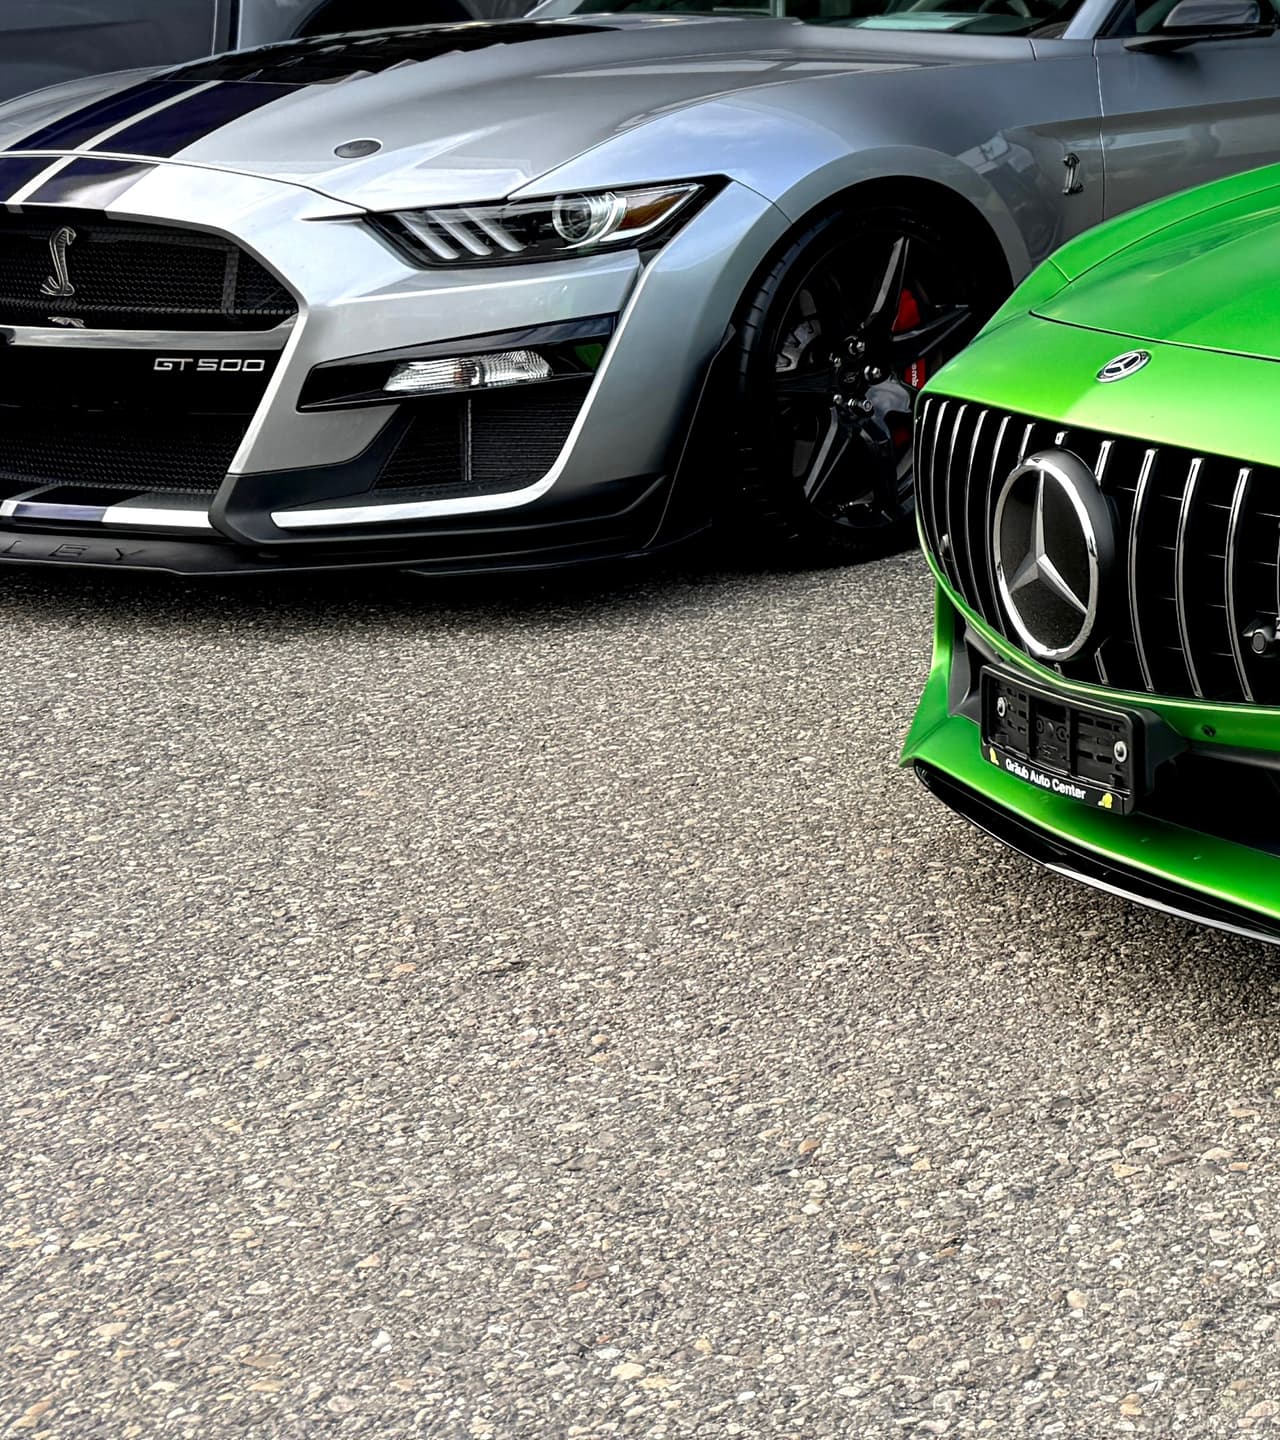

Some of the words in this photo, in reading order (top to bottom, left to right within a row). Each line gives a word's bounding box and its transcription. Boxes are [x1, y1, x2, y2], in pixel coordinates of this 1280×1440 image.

[1005, 758, 1029, 779] Gräub
[1029, 770, 1051, 789] Auto
[1051, 778, 1087, 800] Center
